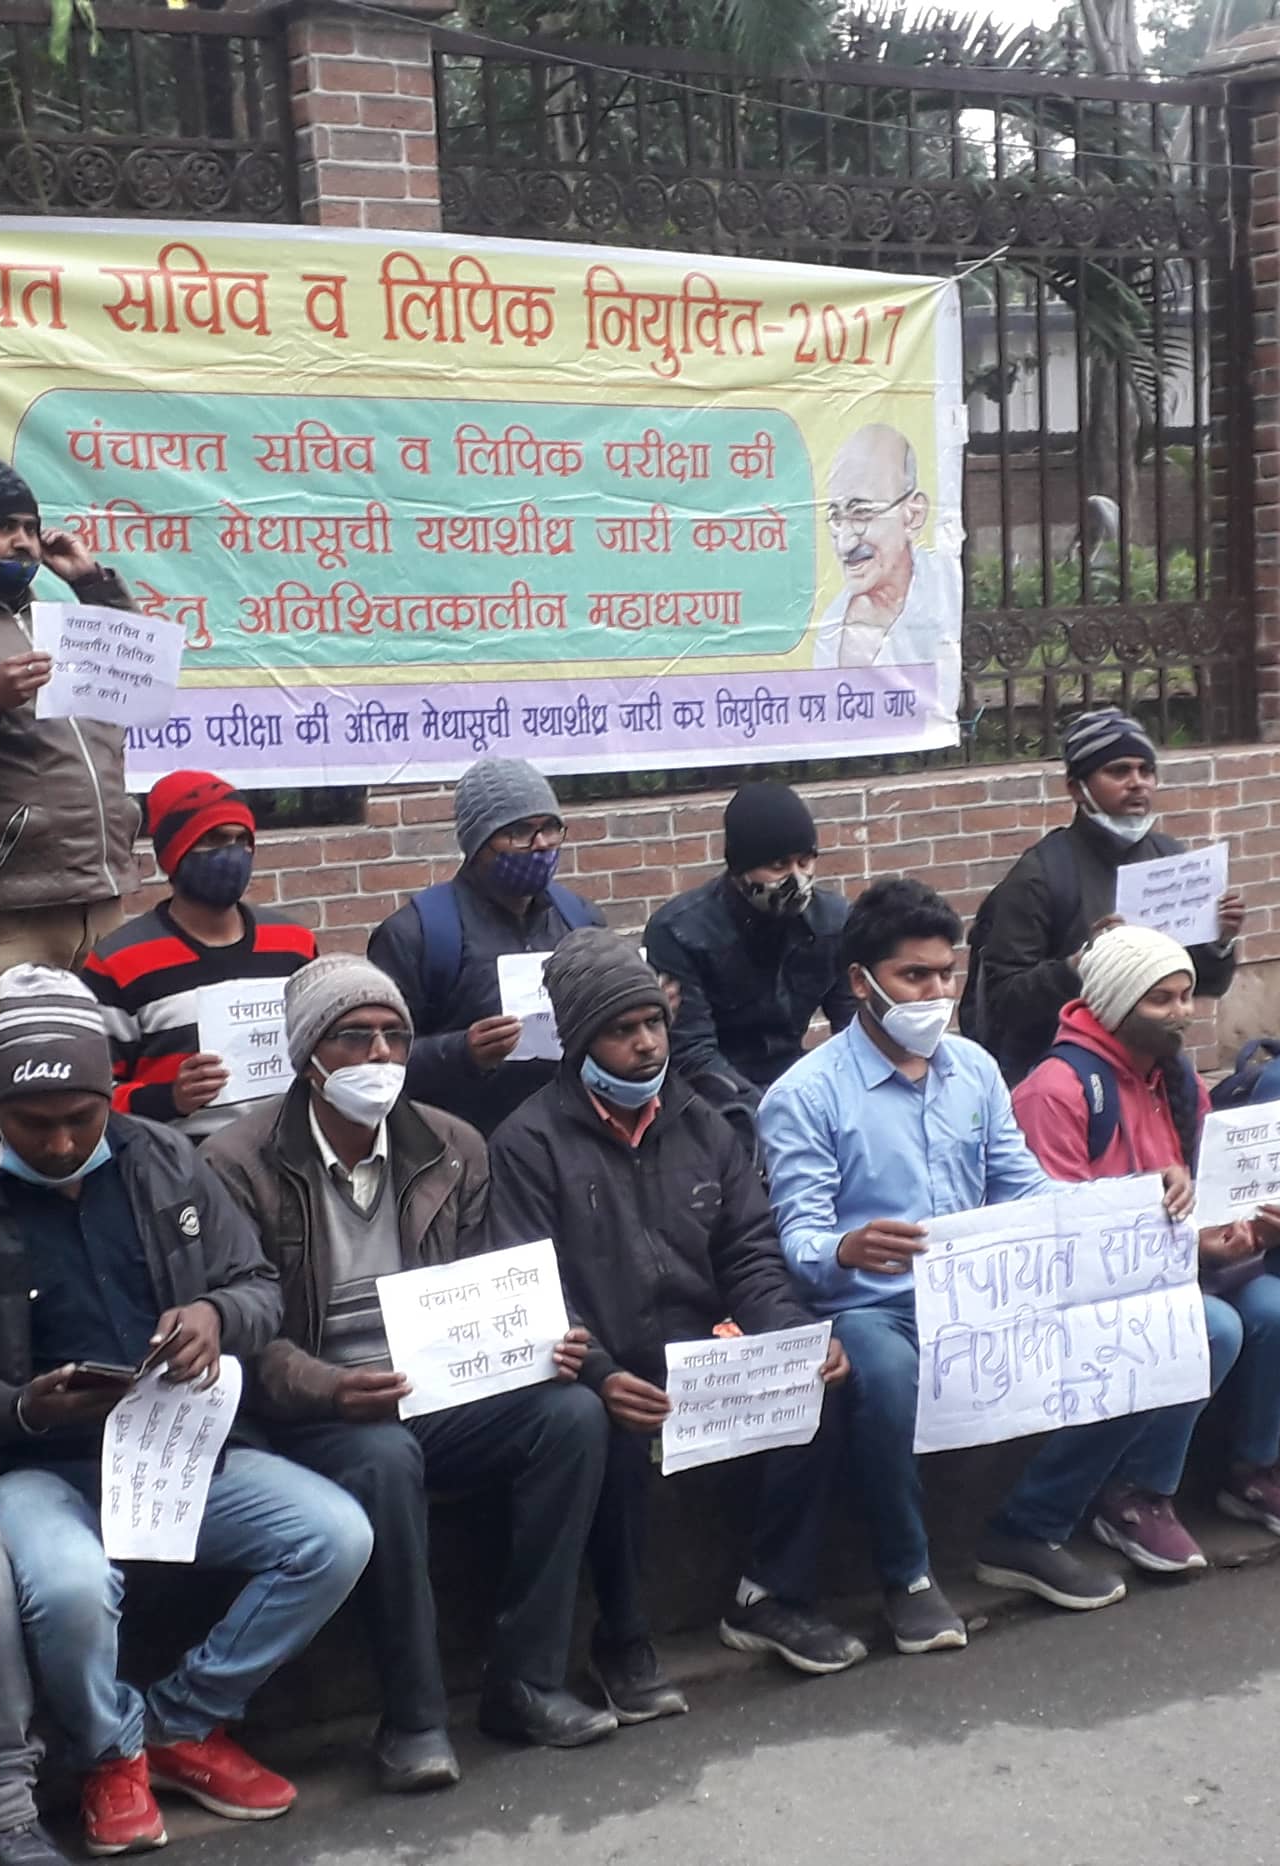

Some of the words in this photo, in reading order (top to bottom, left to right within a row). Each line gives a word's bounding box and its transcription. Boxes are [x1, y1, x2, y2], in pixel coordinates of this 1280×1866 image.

[100, 242, 271, 336] सचिव
[301, 273, 348, 338] व
[379, 250, 555, 347] लिपिक
[66, 419, 228, 472] पंचायत
[252, 419, 375, 474] सचिव
[397, 436, 430, 475] व
[453, 423, 585, 477] लिपिक
[603, 429, 711, 484] परीक्षा
[728, 431, 775, 479] की
[63, 498, 192, 554] अंतिम
[218, 499, 392, 570] मेधासूची
[595, 504, 671, 553] जारी
[690, 504, 788, 552] कराने
[135, 580, 214, 650] हेतु
[239, 579, 568, 636] अनिश्चितकालीन
[587, 590, 742, 632] महाधरणा
[206, 704, 283, 750] परीक्षा
[295, 701, 330, 744] की
[344, 702, 411, 745] अंतिम
[421, 697, 511, 753] मेधासूची
[619, 691, 664, 732] जारी
[673, 699, 705, 729] कर
[716, 687, 790, 738] नियुक्ति
[799, 695, 827, 723] पत्र
[835, 683, 874, 721] दिया
[883, 689, 917, 718] जाए
[228, 1000, 285, 1020] पंचायत
[13, 1060, 72, 1084] class
[247, 1054, 282, 1076] जारी
[491, 1266, 539, 1292] सचिव
[926, 1232, 1082, 1321] पंचायत
[491, 1304, 529, 1338] सूची
[447, 1352, 489, 1379] जारी
[500, 1338, 535, 1367] करो
